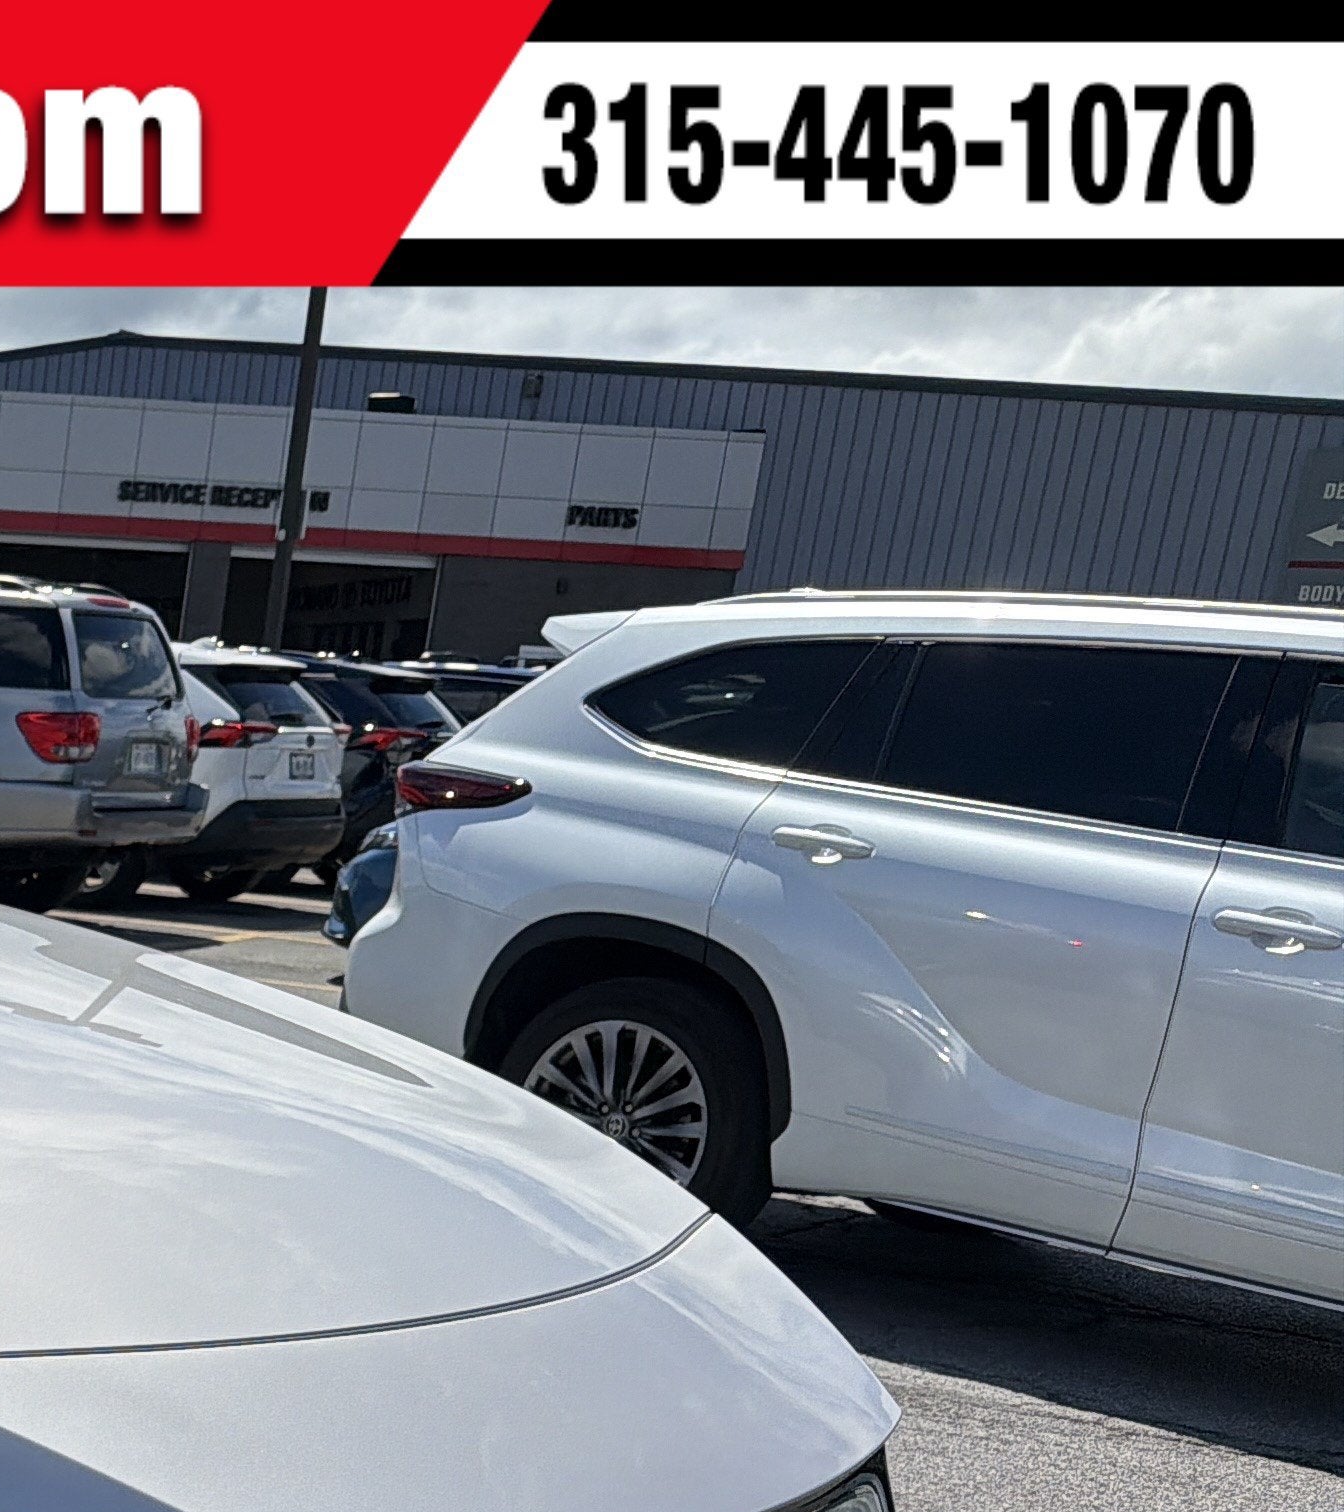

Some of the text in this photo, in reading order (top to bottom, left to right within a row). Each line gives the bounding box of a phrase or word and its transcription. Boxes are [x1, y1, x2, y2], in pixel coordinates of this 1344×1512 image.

[118, 480, 208, 505] SERVICE
[566, 505, 639, 529] PARTS
[1298, 584, 1344, 602] BODY
